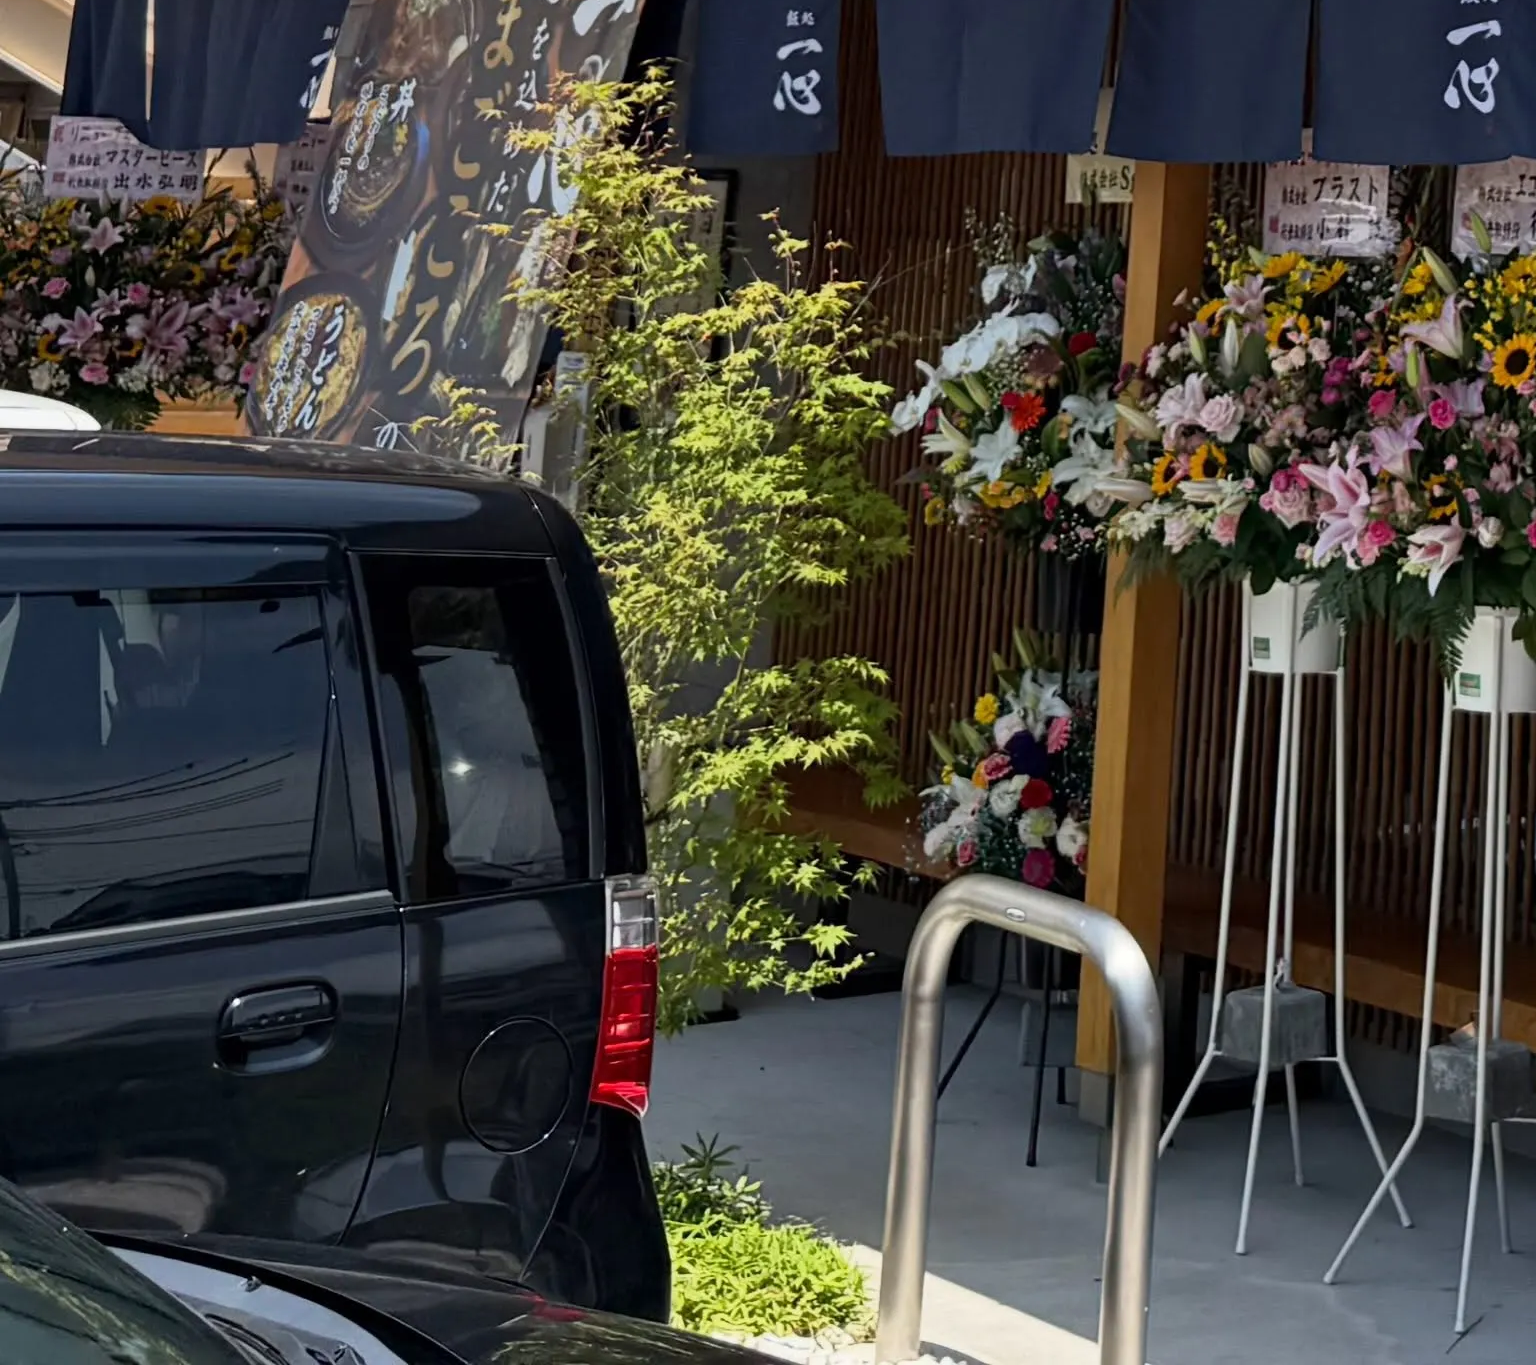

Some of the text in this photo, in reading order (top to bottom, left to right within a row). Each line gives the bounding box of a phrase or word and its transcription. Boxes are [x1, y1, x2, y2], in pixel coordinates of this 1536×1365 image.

[773, 38, 823, 115] 一心
[1443, 20, 1502, 115] 一心
[295, 305, 345, 430] うどん
